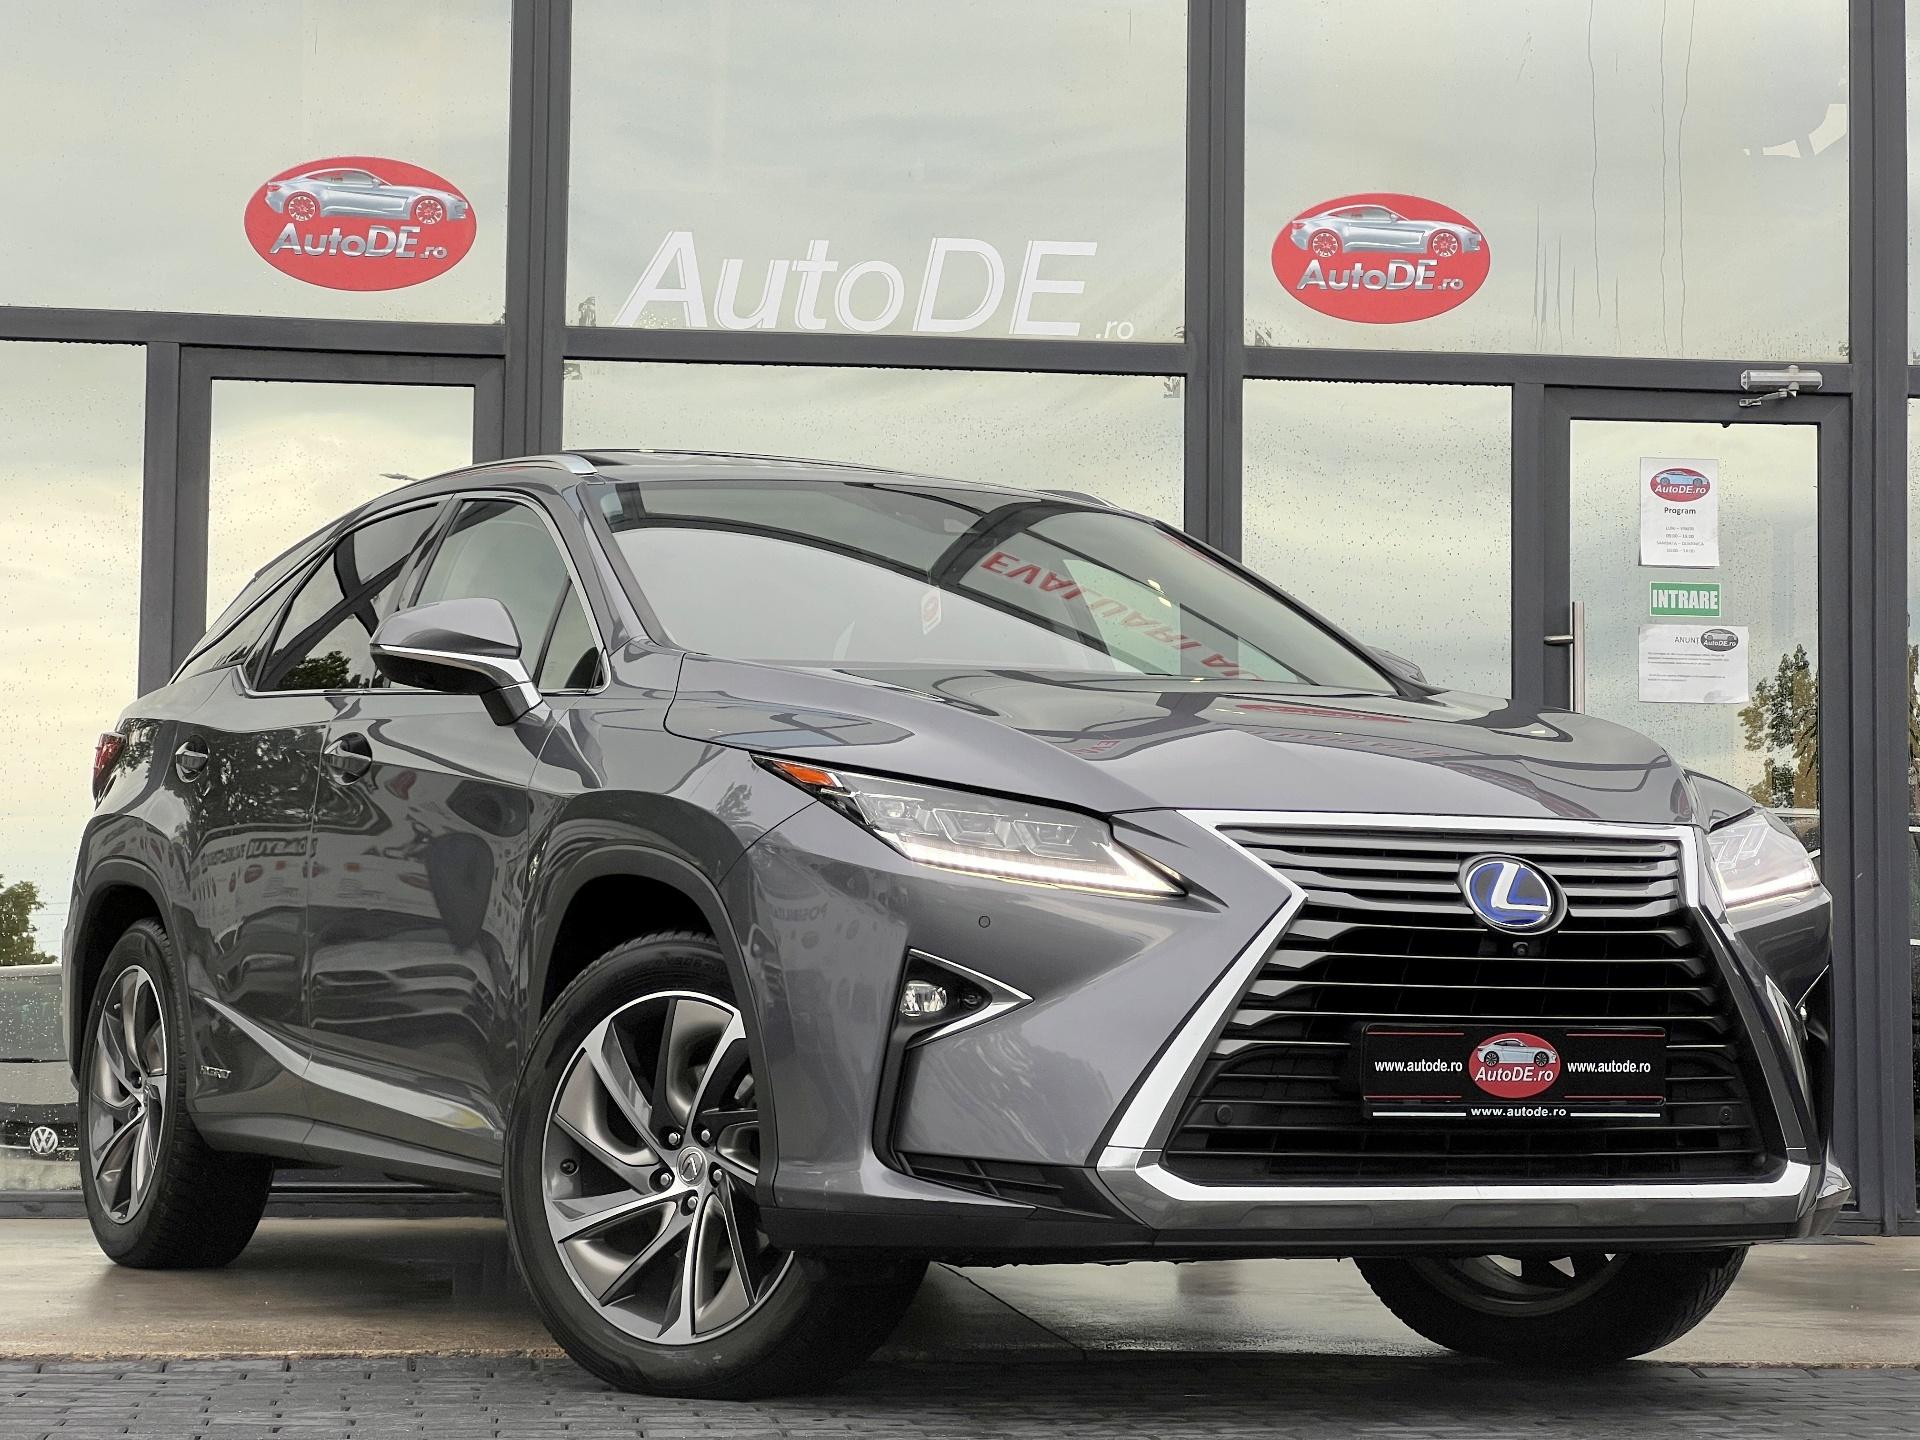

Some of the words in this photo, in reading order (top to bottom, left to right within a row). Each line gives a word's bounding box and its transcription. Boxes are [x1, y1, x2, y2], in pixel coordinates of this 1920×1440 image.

[269, 223, 448, 259] AutoDE.ro
[1296, 259, 1464, 291] AutoDE.ro
[1655, 485, 1707, 494] AutoDE.ro
[1664, 507, 1697, 515] Program
[1652, 589, 1719, 609] INTRARE
[1703, 639, 1737, 647] AutoDE.ro
[1374, 1059, 1463, 1073] www.autode.ro
[1567, 1060, 1651, 1073] www.autode.ro
[1474, 1066, 1554, 1082] AutoDE.ro
[1470, 1106, 1567, 1117] www.autode.ro
